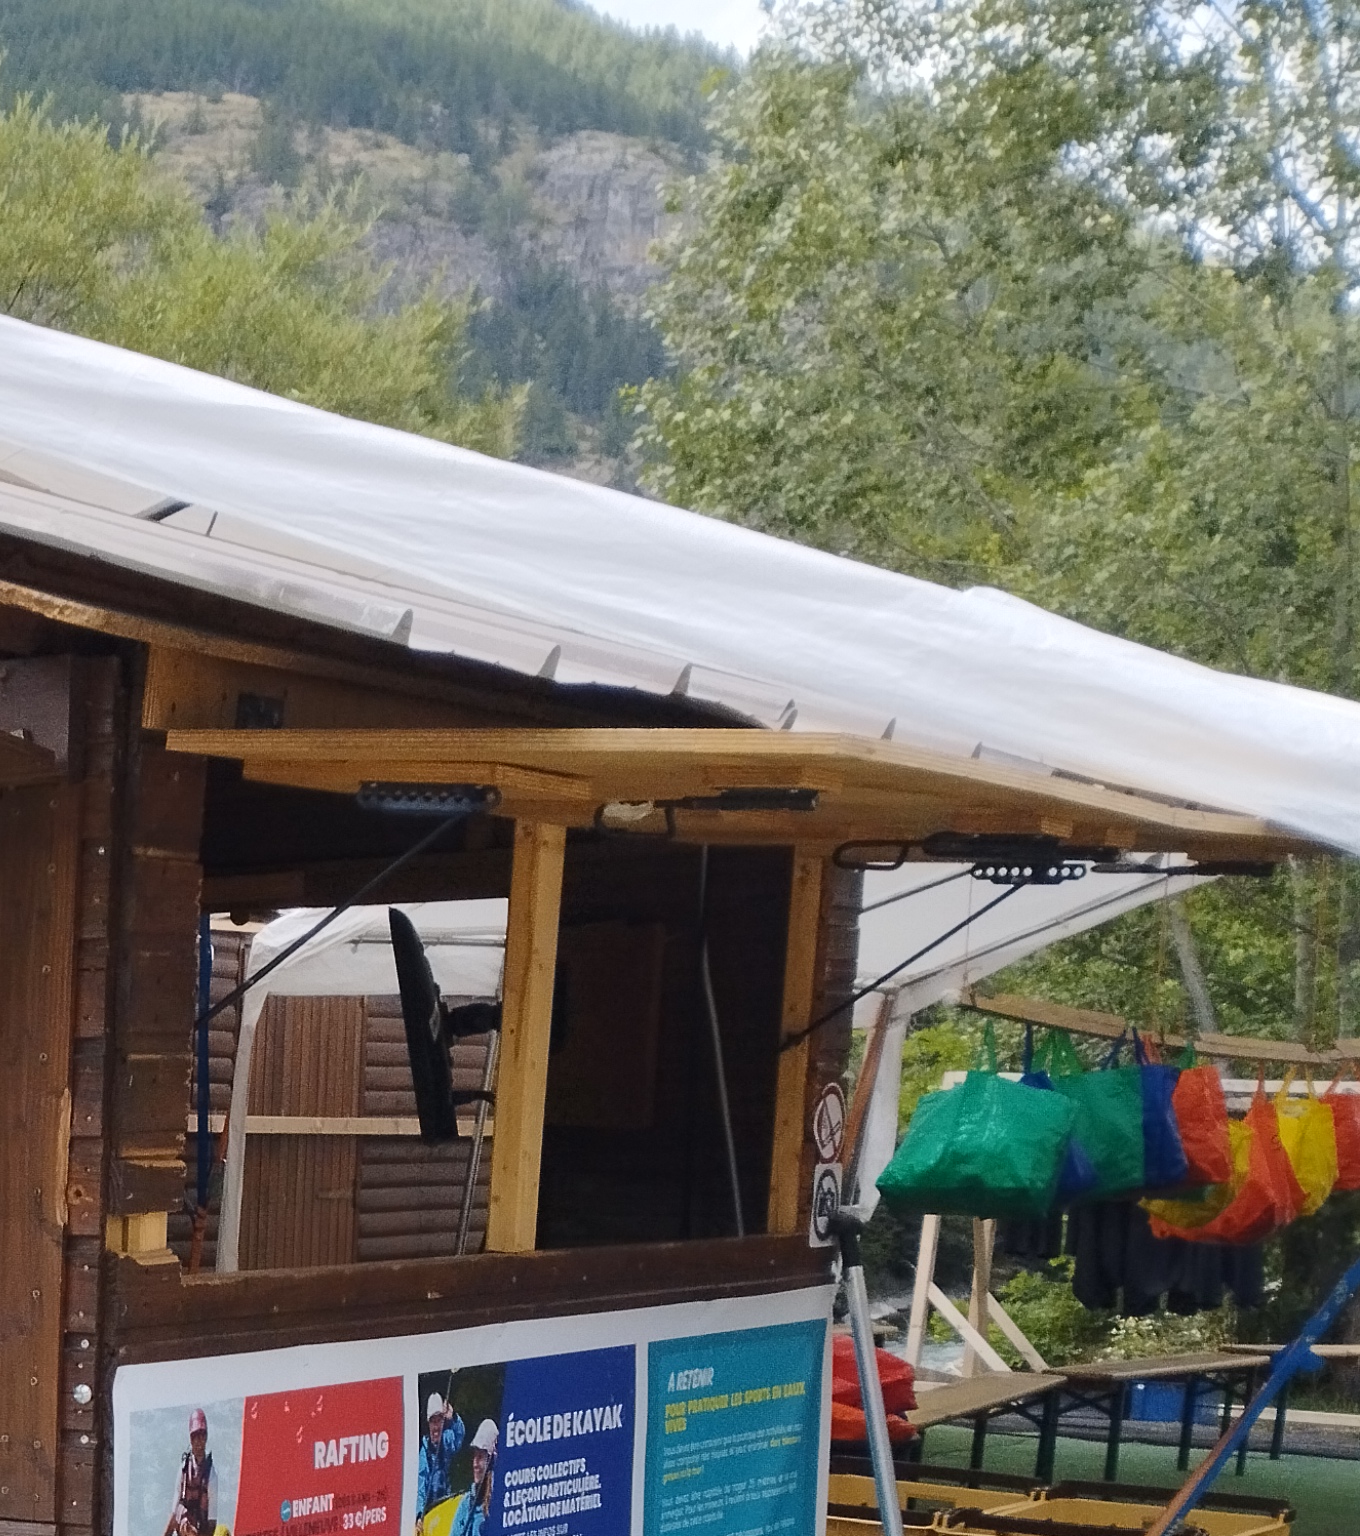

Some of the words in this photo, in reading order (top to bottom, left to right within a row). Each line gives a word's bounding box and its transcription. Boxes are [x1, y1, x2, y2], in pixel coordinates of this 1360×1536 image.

[676, 1366, 714, 1391] RETENIR
[506, 1412, 552, 1448] ÉCOLE
[552, 1411, 572, 1440] DE
[572, 1403, 623, 1436] KAYAK
[314, 1431, 389, 1469] RAFTING
[504, 1466, 536, 1488] COURS
[536, 1457, 586, 1481] COLLECTIFS
[292, 1493, 335, 1518] ENFANT
[511, 1485, 541, 1507] LEÇON
[342, 1512, 354, 1530] 33
[502, 1503, 550, 1528] LOCATION
[550, 1500, 562, 1518] DE
